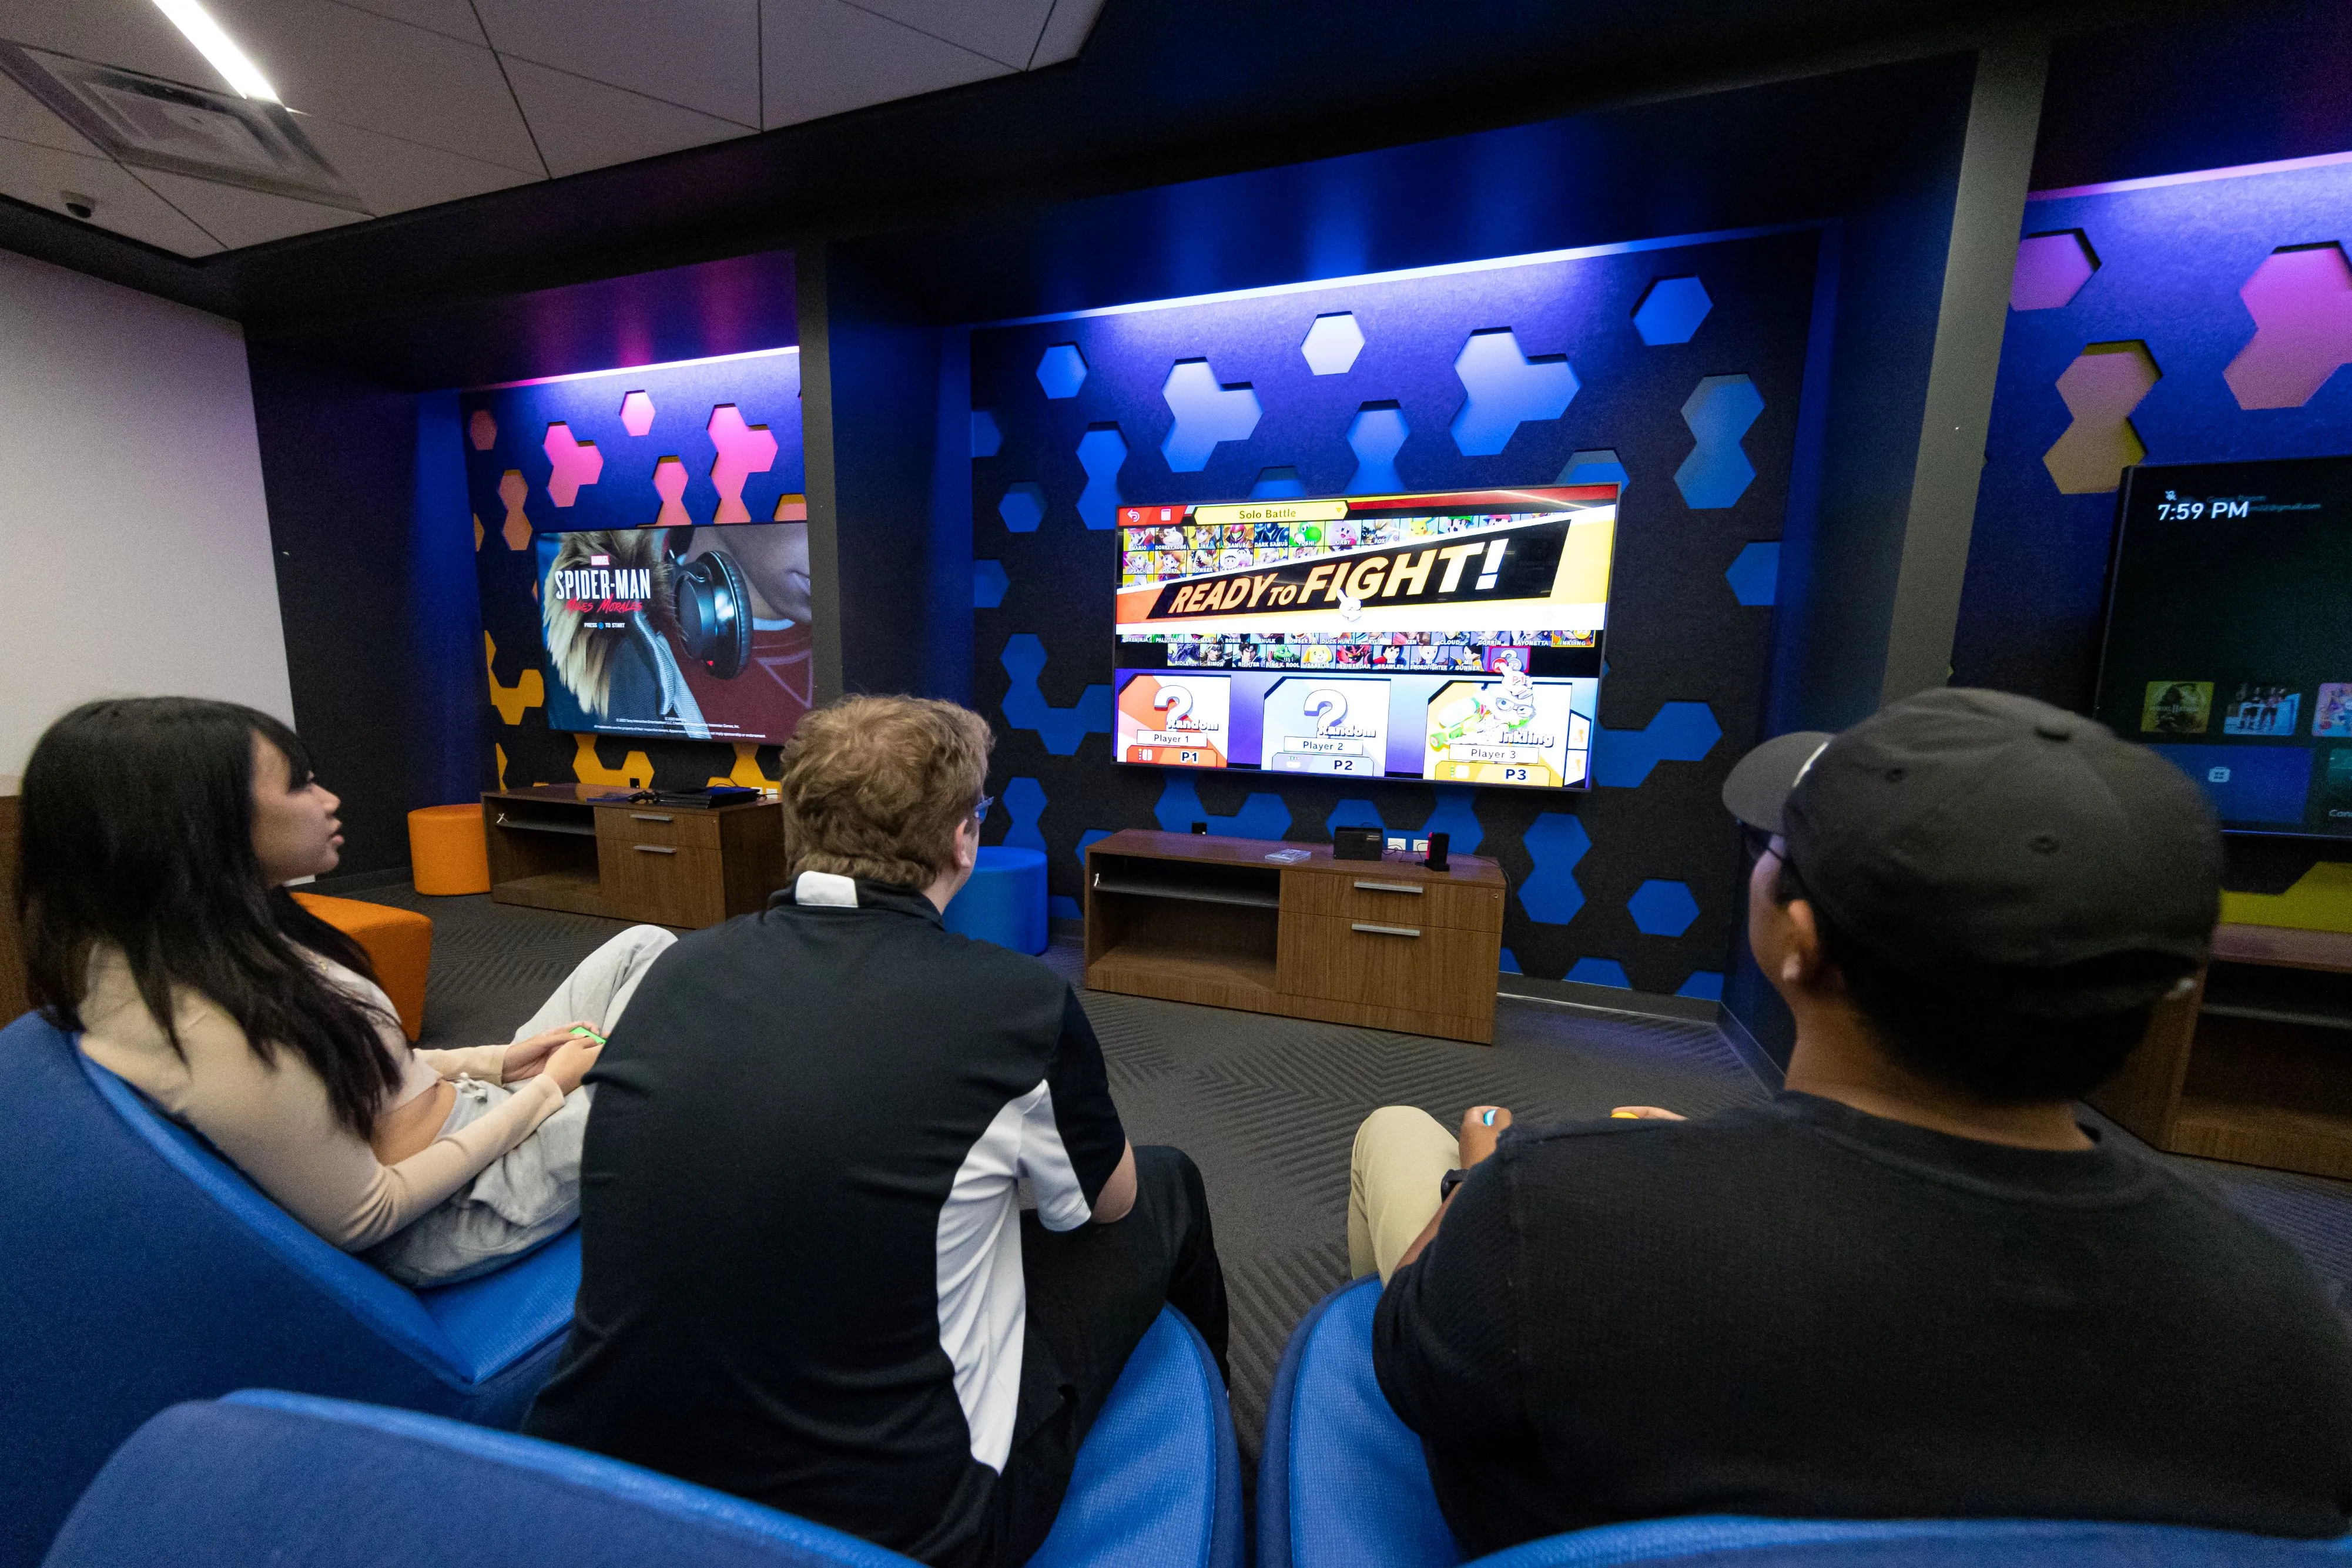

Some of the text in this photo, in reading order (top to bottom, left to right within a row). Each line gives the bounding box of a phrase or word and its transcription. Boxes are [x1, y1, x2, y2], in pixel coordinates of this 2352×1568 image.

[1239, 509, 1296, 519] Solo Battle
[2158, 503, 2204, 520] 7:59
[2211, 501, 2249, 518] PM
[1168, 538, 1509, 614] READY TO FIGHT!
[555, 569, 651, 601] SPIDER-MAN
[1167, 720, 1218, 731] Random
[1317, 726, 1376, 738] Random
[1154, 734, 1181, 743] Player
[1499, 731, 1554, 748] Inkling
[1303, 741, 1333, 751] Player
[1182, 752, 1197, 762] P1
[1471, 749, 1505, 759] Player
[1334, 760, 1353, 770] P2
[1506, 769, 1526, 780] P3
